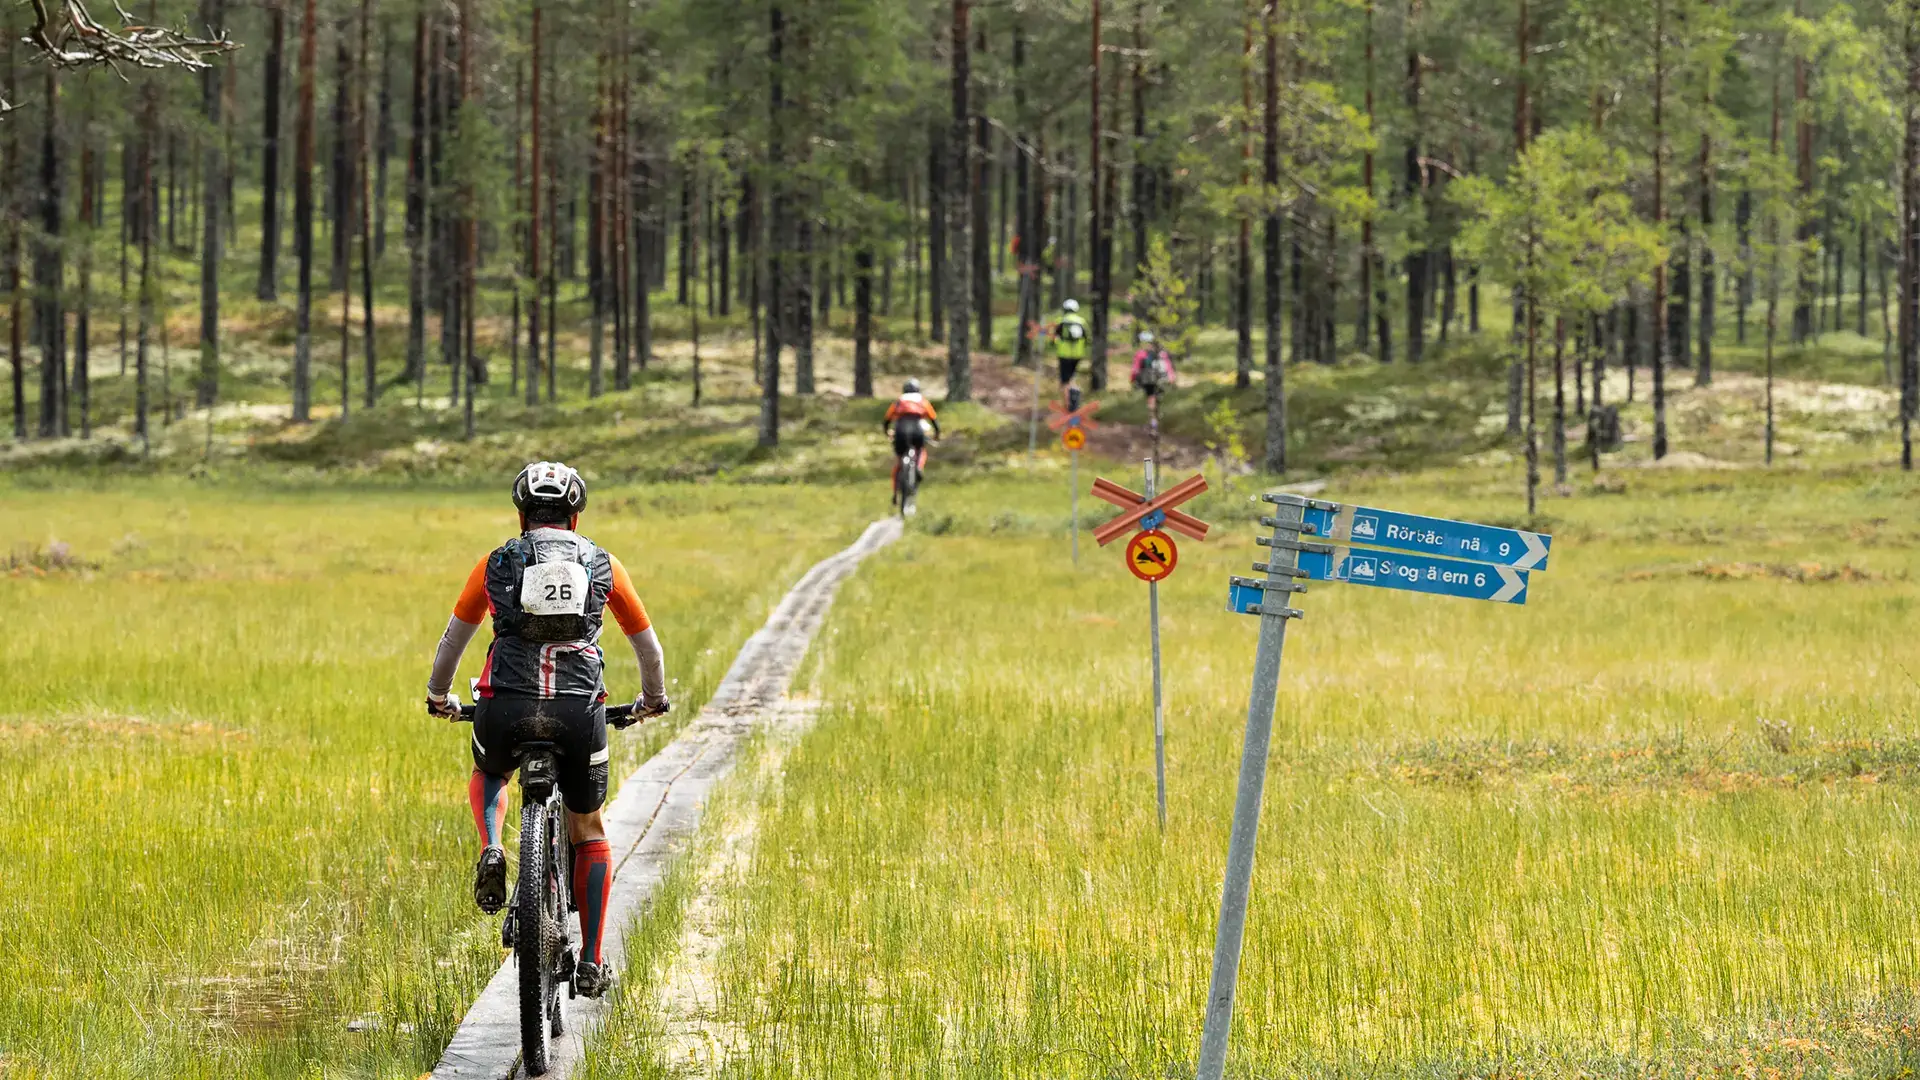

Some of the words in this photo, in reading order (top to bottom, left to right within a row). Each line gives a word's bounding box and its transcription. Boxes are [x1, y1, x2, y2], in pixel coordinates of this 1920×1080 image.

[1386, 524, 1488, 553] Rörbäcnä
[1498, 542, 1511, 557] 9
[1379, 560, 1469, 585] Skogäern
[1473, 572, 1487, 588] 6
[544, 584, 572, 600] 26
